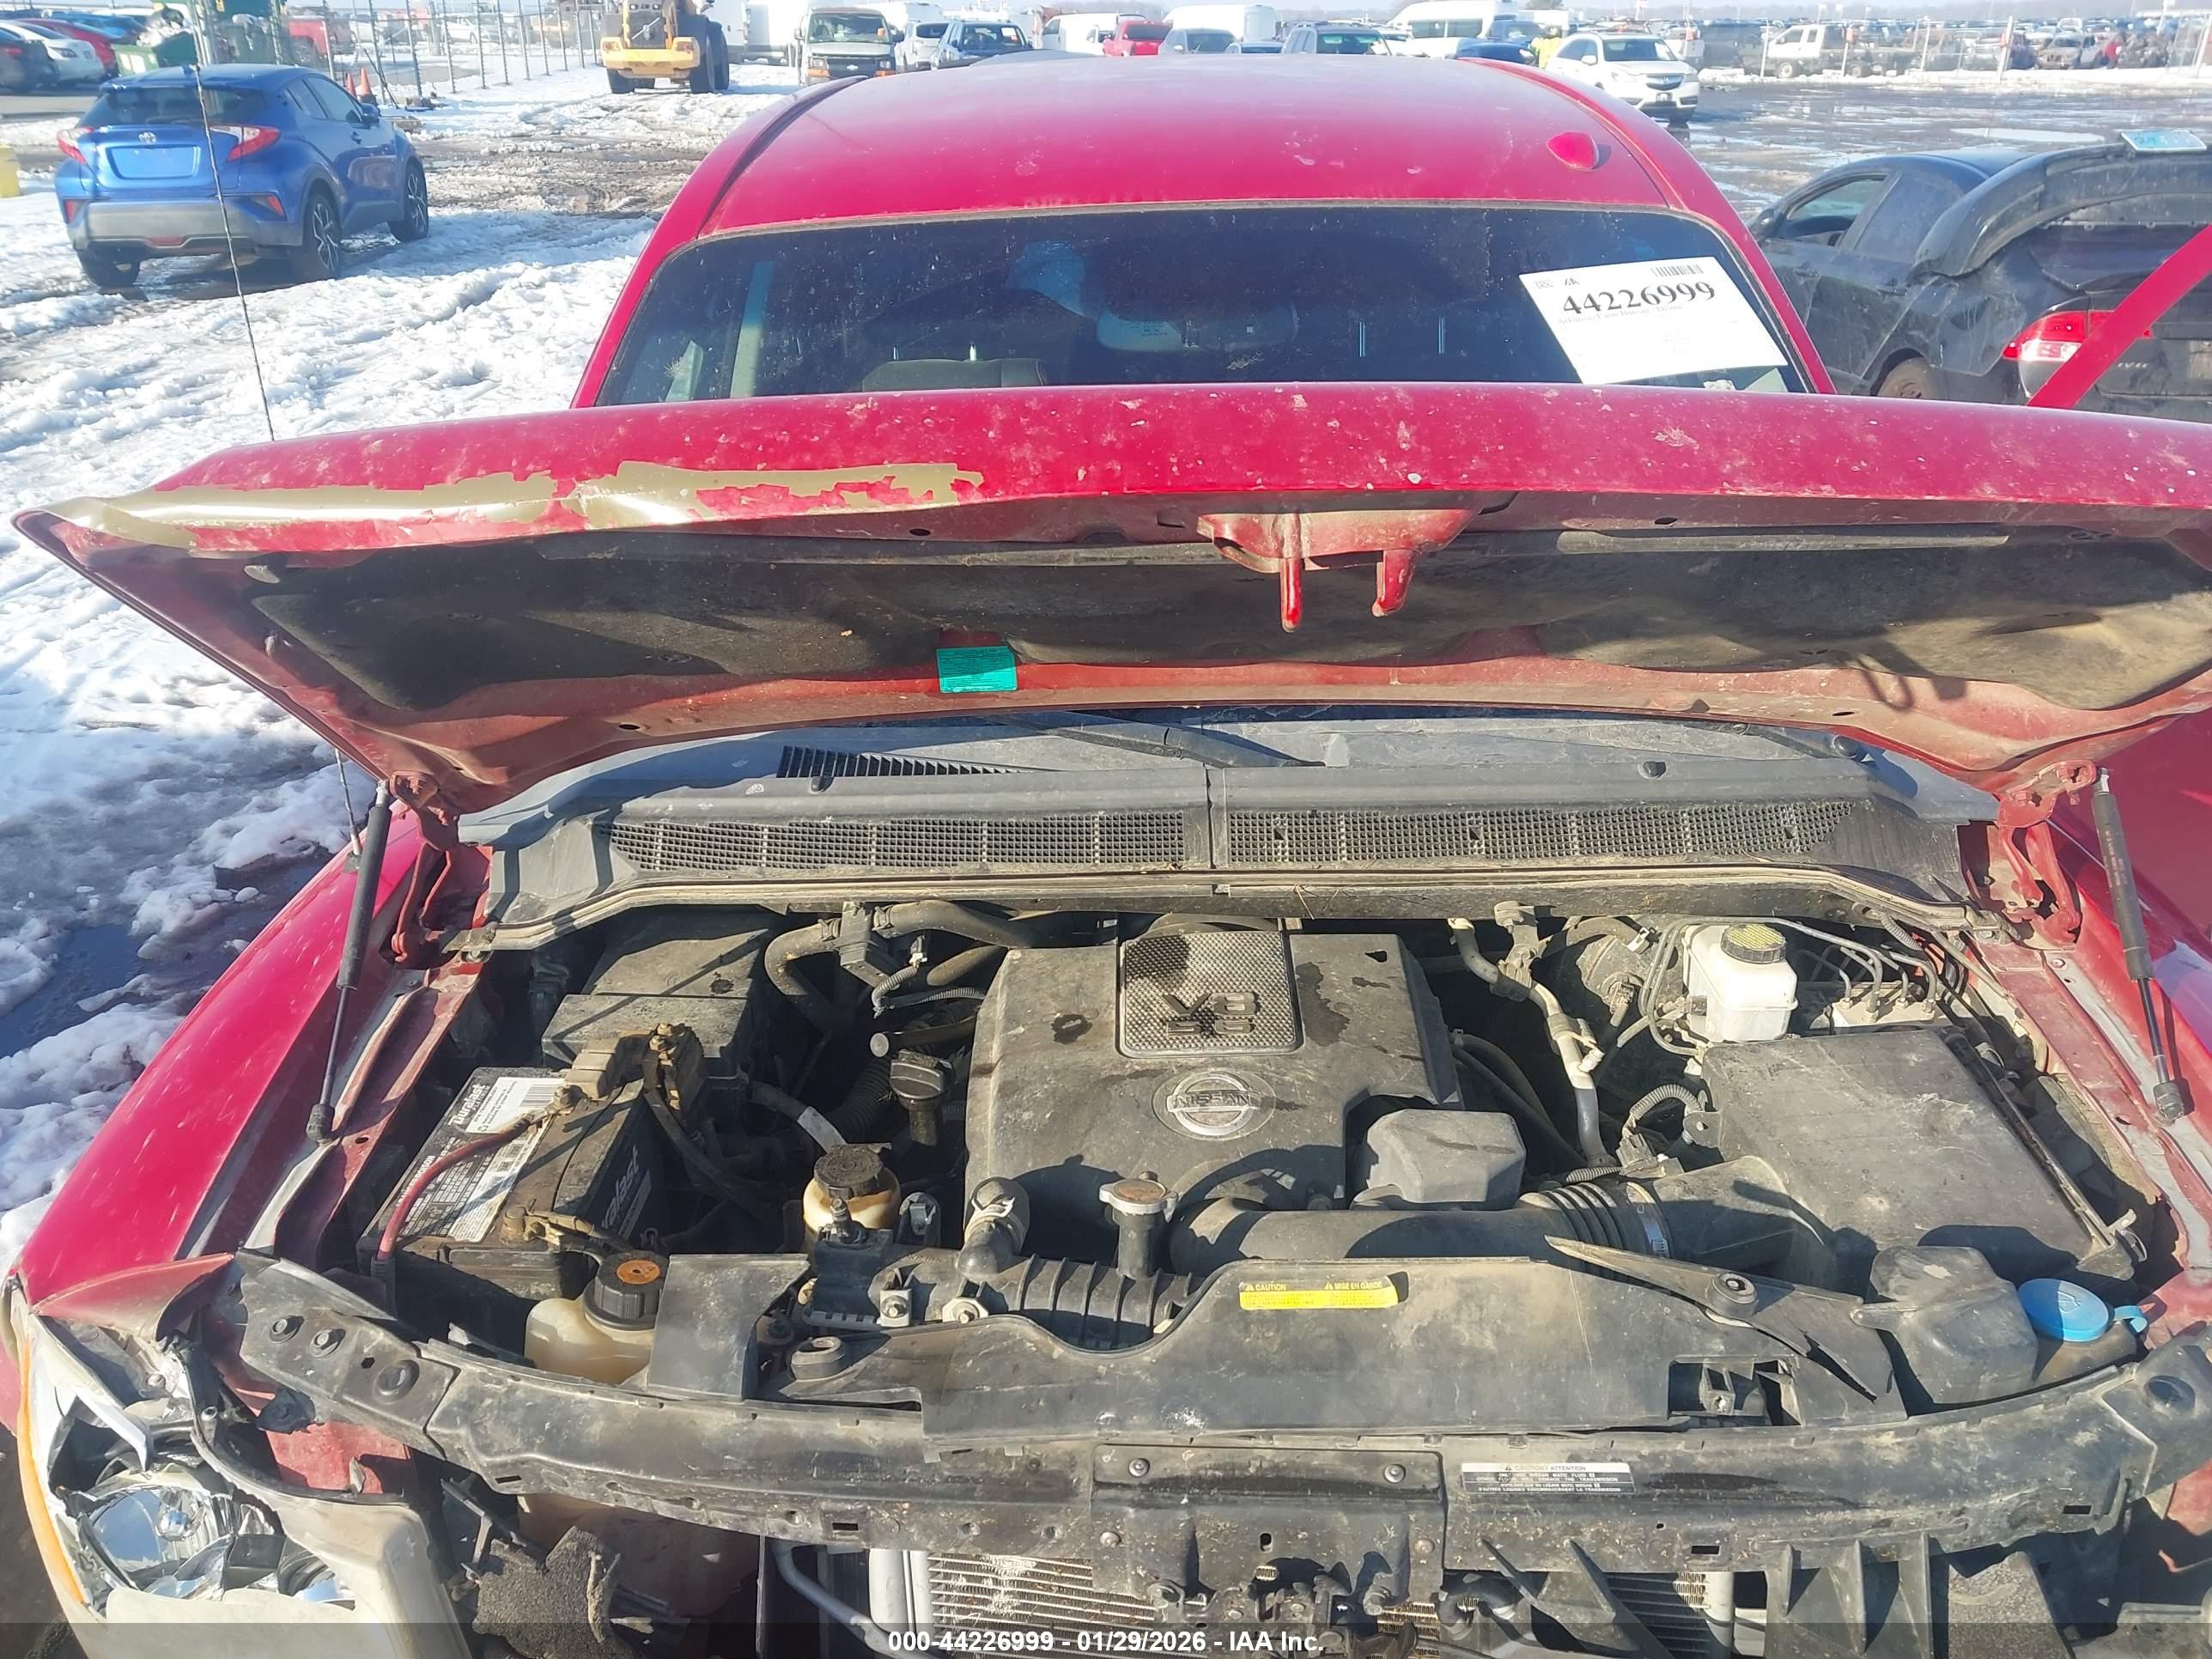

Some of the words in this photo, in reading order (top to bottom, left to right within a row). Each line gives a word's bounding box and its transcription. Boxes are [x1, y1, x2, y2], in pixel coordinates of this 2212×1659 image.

[1563, 281, 1715, 314] 44226999
[447, 1083, 486, 1127] Duralast
[1173, 1090, 1251, 1109] NISSAN
